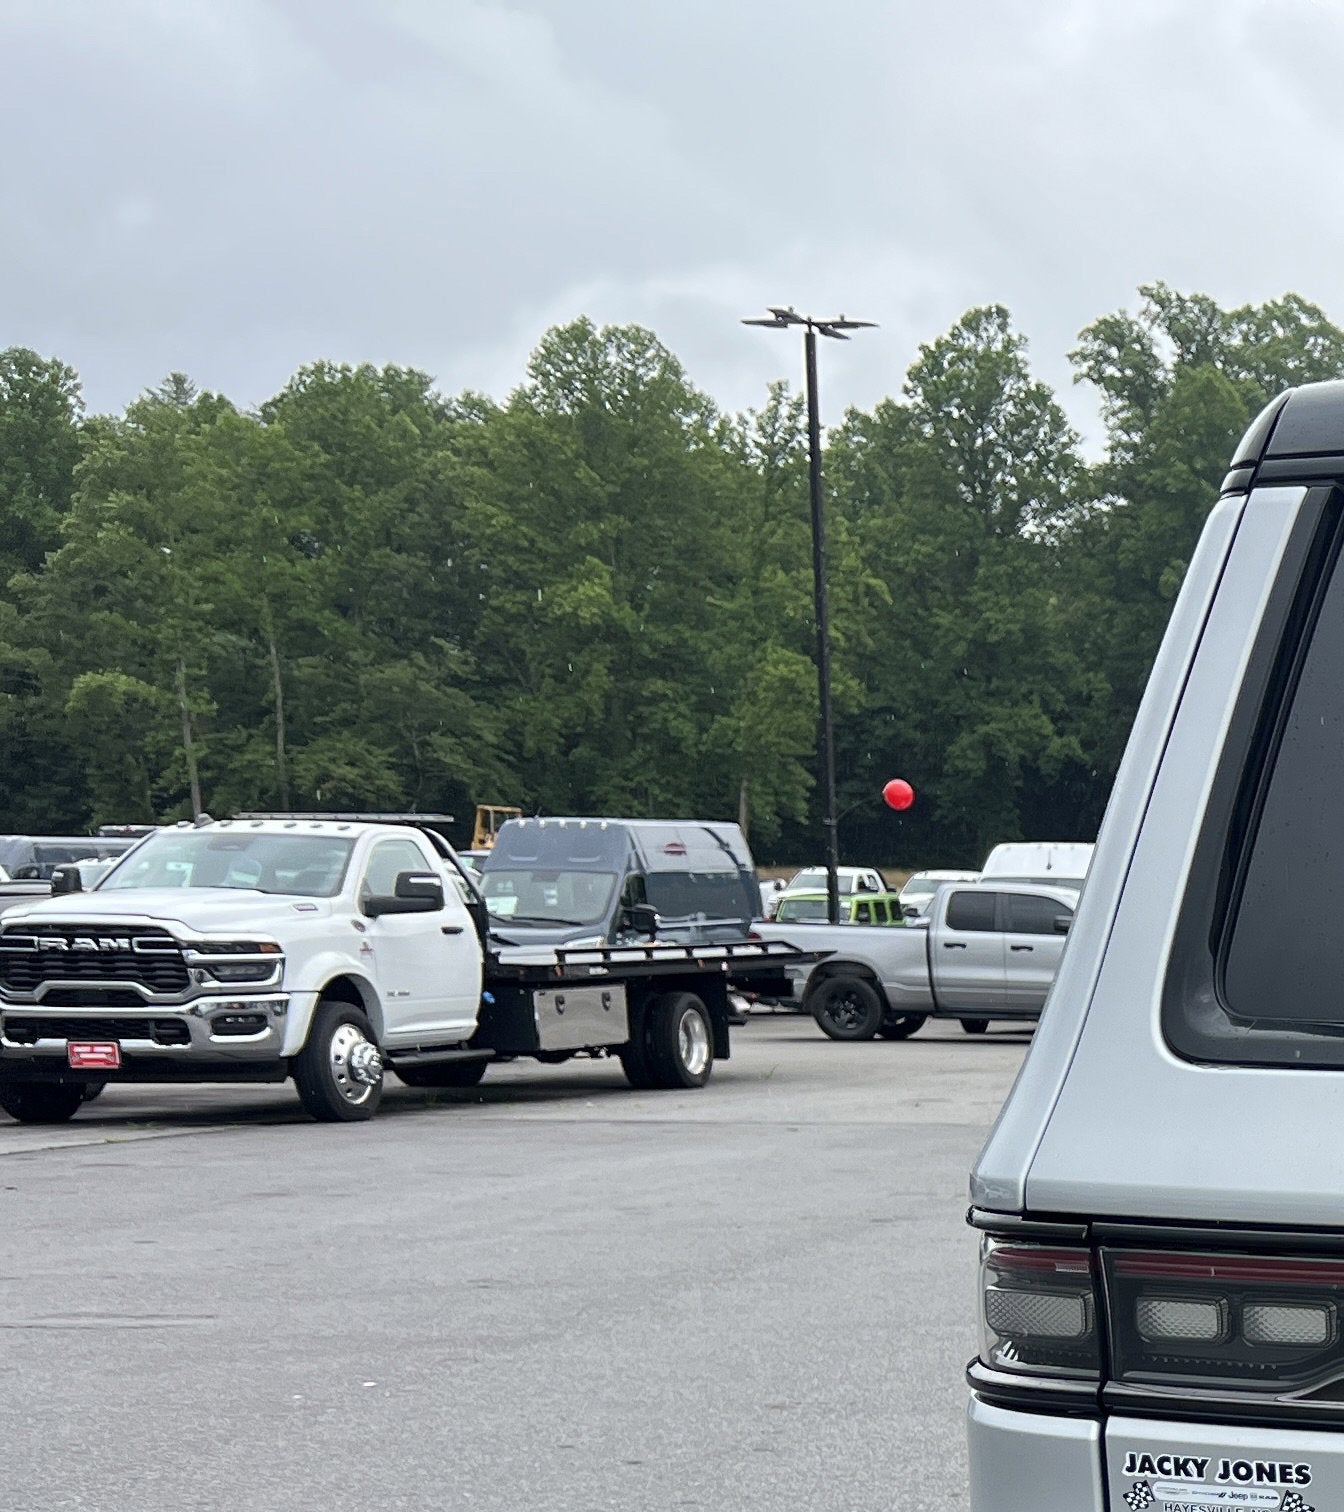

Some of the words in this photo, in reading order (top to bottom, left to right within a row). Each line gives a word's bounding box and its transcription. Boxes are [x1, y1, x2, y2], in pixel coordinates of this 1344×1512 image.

[38, 937, 130, 951] RAM
[1124, 1453, 1209, 1478] JACKY
[1218, 1460, 1312, 1486] JONES
